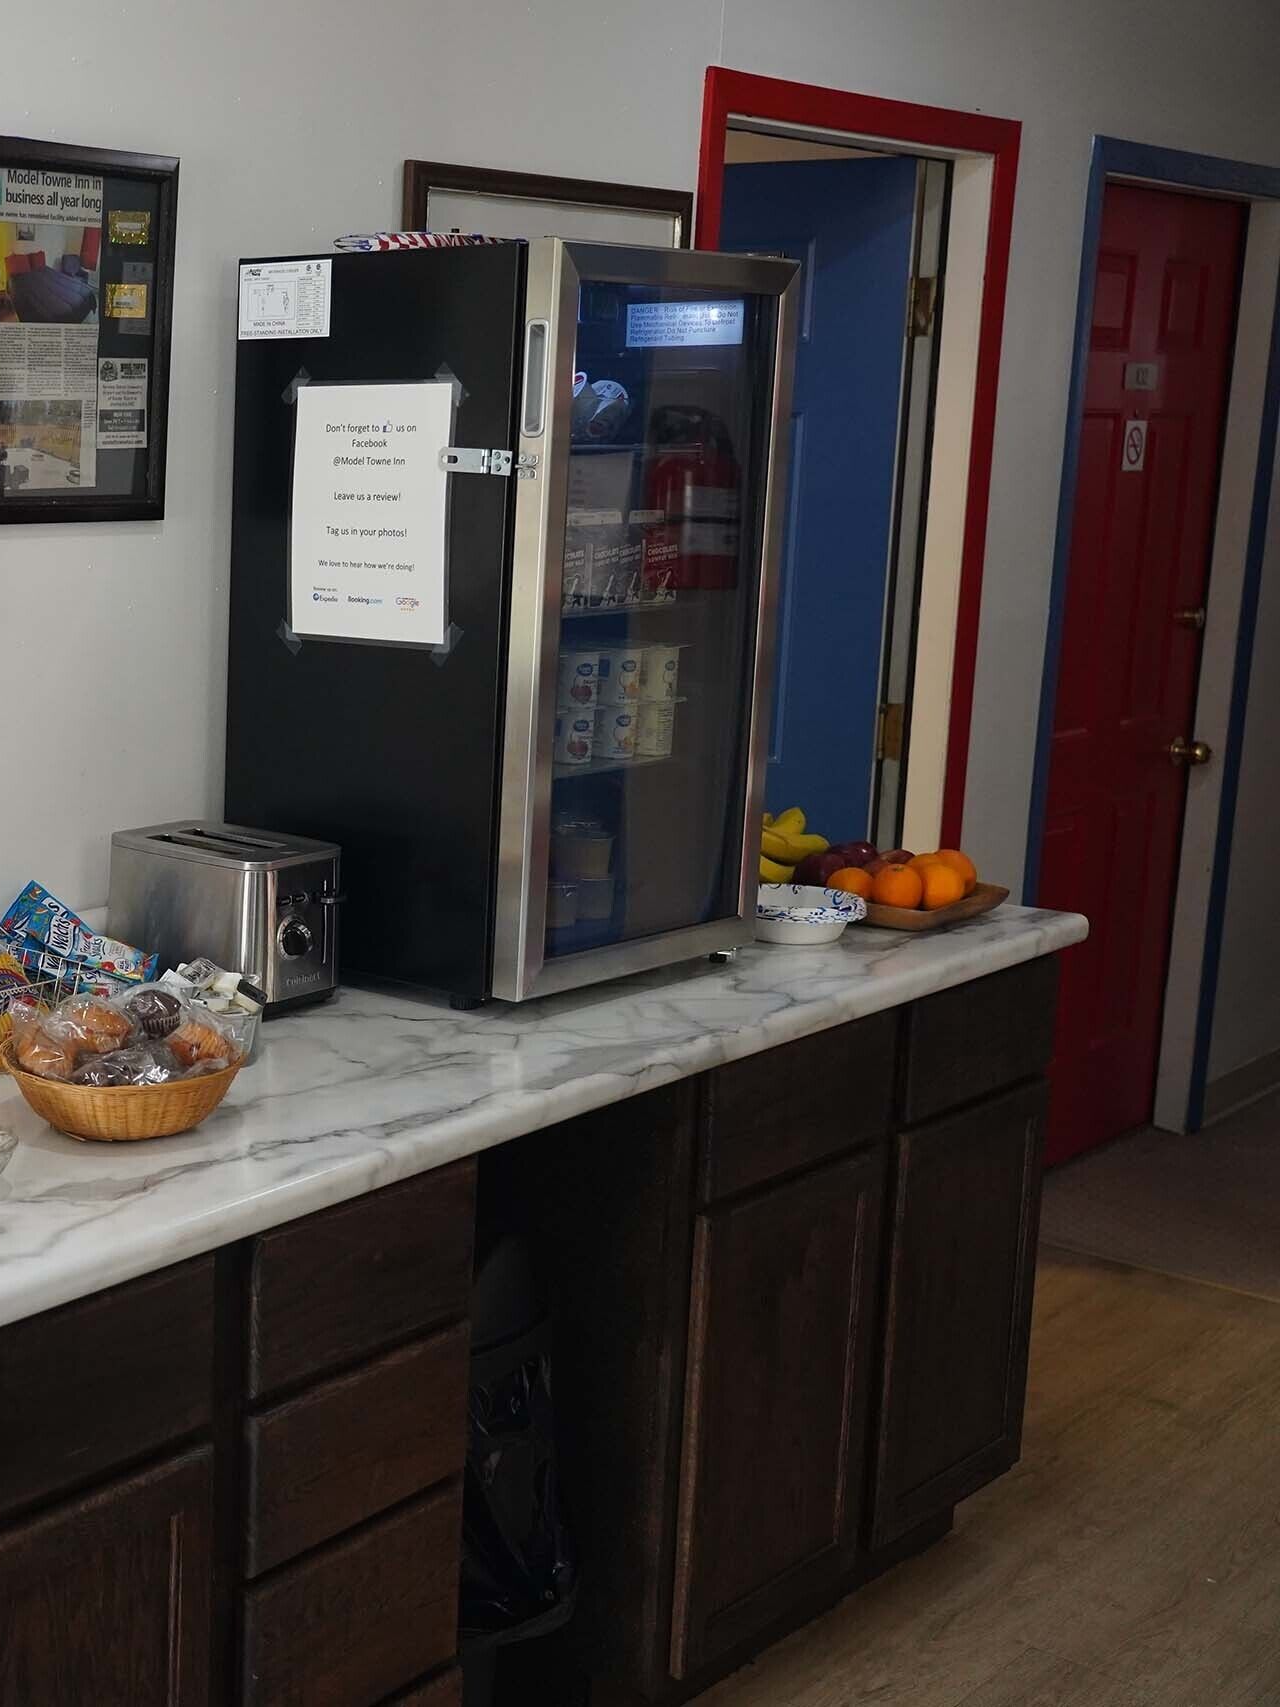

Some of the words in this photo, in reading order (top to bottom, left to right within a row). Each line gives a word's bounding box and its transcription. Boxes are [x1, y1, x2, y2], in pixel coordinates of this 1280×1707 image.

[7, 169, 39, 185] Model
[40, 172, 72, 188] Towne
[74, 175, 90, 189] Inn
[92, 176, 102, 190] in
[5, 188, 45, 205] business
[46, 191, 59, 206] all
[60, 194, 80, 210] year
[81, 194, 102, 213] long
[727, 310, 739, 319] Not
[325, 423, 346, 433] Don't
[347, 423, 370, 435] forget
[371, 424, 380, 433] to
[395, 424, 405, 433] us
[406, 424, 417, 433] on
[351, 438, 388, 448] Facebook
[332, 455, 365, 467] @Model
[366, 456, 392, 466] Towne
[393, 456, 406, 466] Inn
[333, 491, 355, 501] Leave
[356, 492, 366, 501] us
[366, 493, 372, 501] a
[372, 491, 401, 502] review!
[326, 525, 340, 537] Tag
[340, 526, 350, 536] us
[350, 526, 358, 536] in
[359, 527, 377, 538] your
[377, 527, 408, 539] photos!
[318, 559, 328, 567] We
[328, 559, 341, 568] love
[342, 560, 349, 568] to
[349, 560, 363, 569] hear
[363, 561, 377, 569] how
[377, 561, 395, 570] we're
[395, 562, 415, 573] doing!
[347, 595, 383, 605] Booking.com
[395, 597, 420, 608] Google
[51, 918, 71, 951] Welch's
